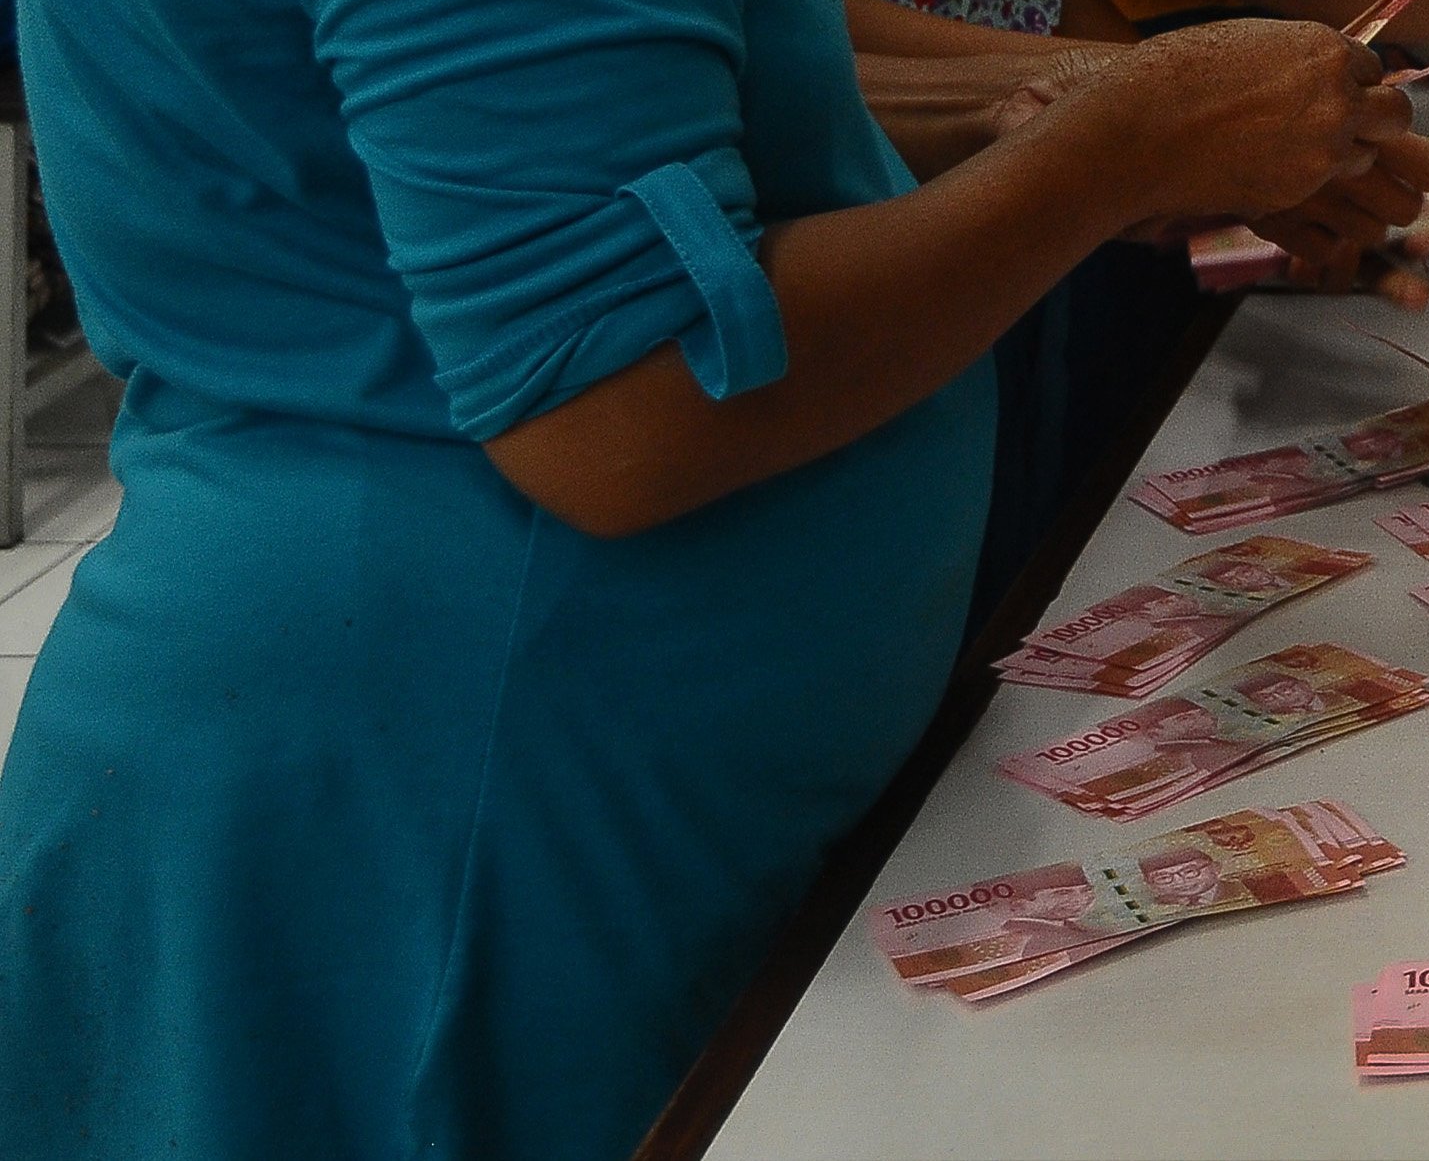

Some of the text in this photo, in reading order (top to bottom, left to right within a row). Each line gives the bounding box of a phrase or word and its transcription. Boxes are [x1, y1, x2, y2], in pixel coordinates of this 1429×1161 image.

[1042, 604, 1128, 642] 100000
[1036, 719, 1140, 762] 100000
[885, 883, 1015, 924] 100000
